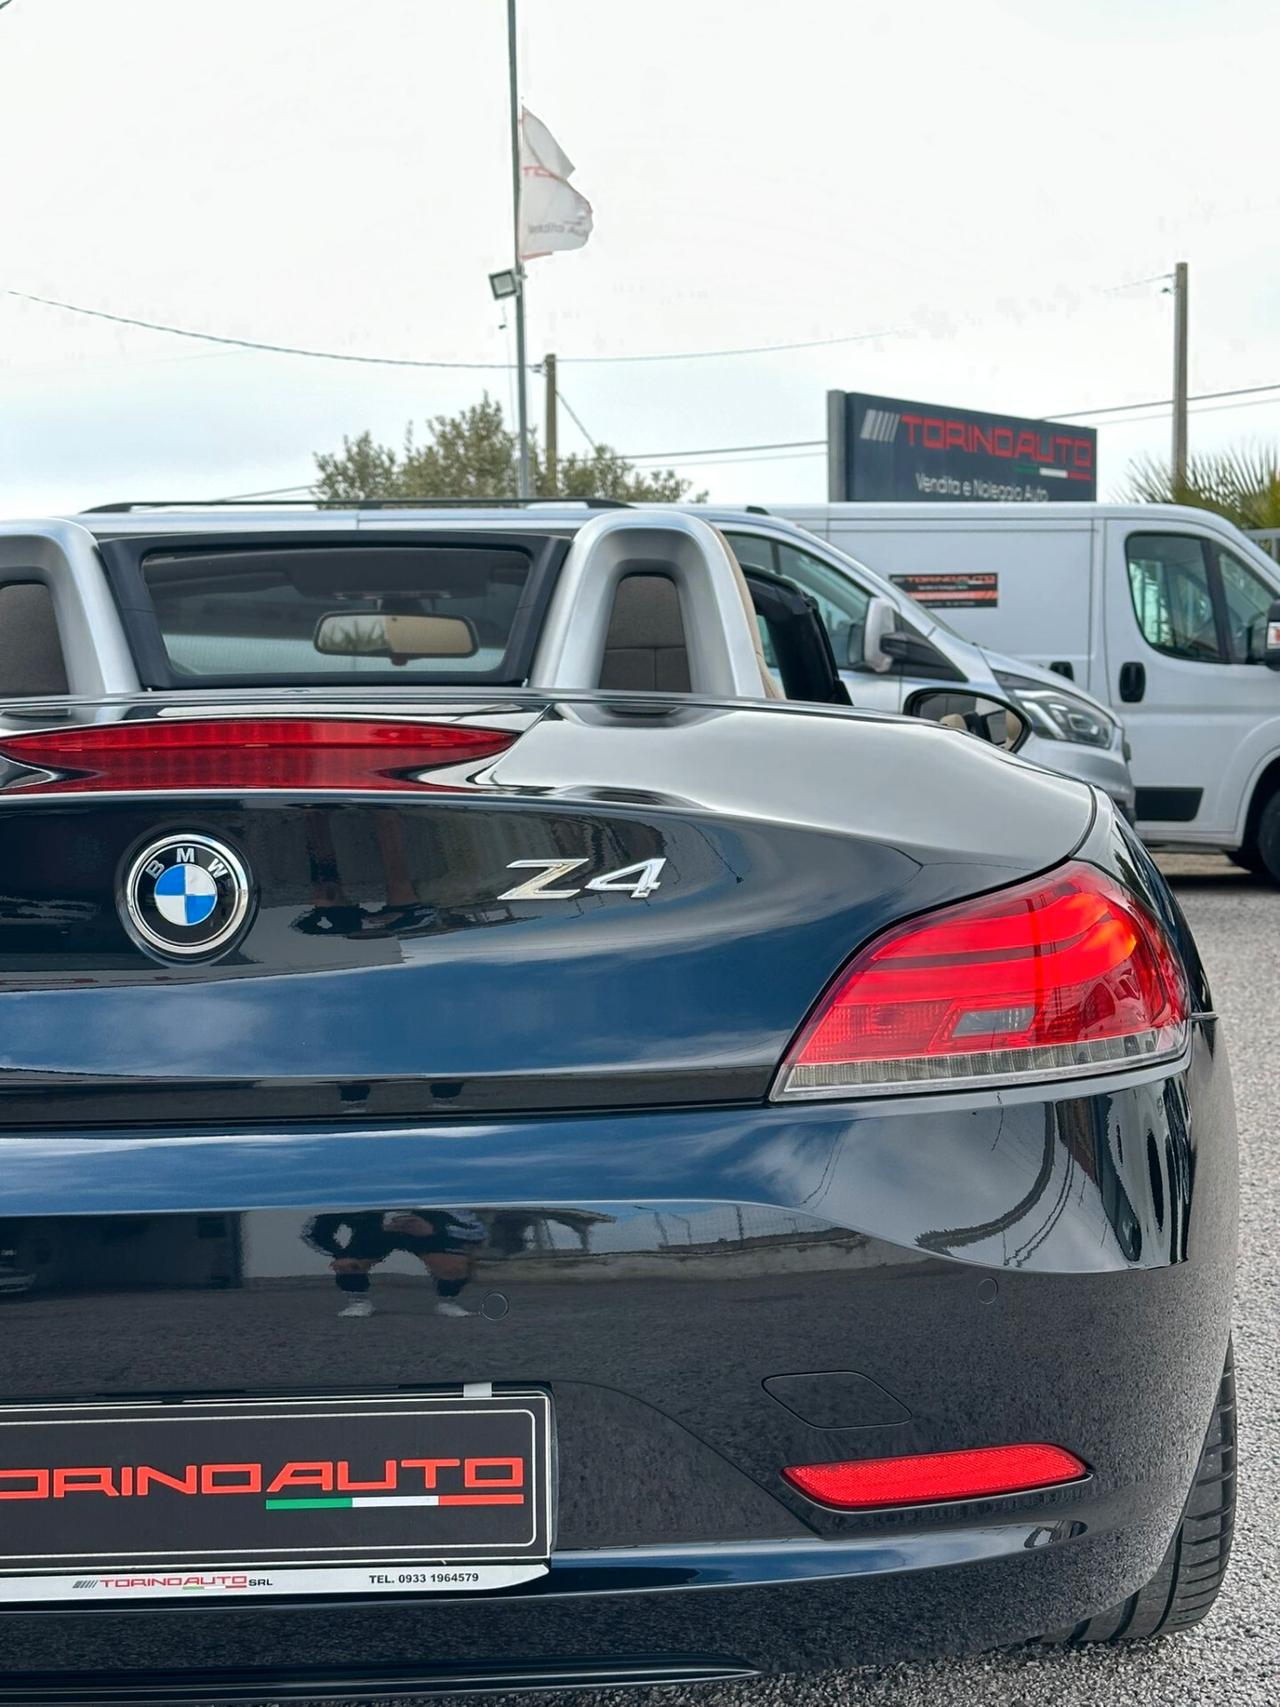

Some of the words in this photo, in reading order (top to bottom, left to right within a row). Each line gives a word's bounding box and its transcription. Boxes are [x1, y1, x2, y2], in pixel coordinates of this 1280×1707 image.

[901, 414, 1093, 468] TORINOAUTO
[915, 472, 960, 496] Vendita
[962, 480, 972, 496] e
[1024, 484, 1049, 502] Auto
[145, 847, 229, 880] BMW
[497, 857, 667, 901] Z4
[100, 1575, 248, 1588] TORINOAUTO
[248, 1578, 273, 1587] SRL
[368, 1574, 396, 1584] TEL.
[398, 1573, 427, 1584] 0933
[430, 1572, 480, 1583] 1964579
